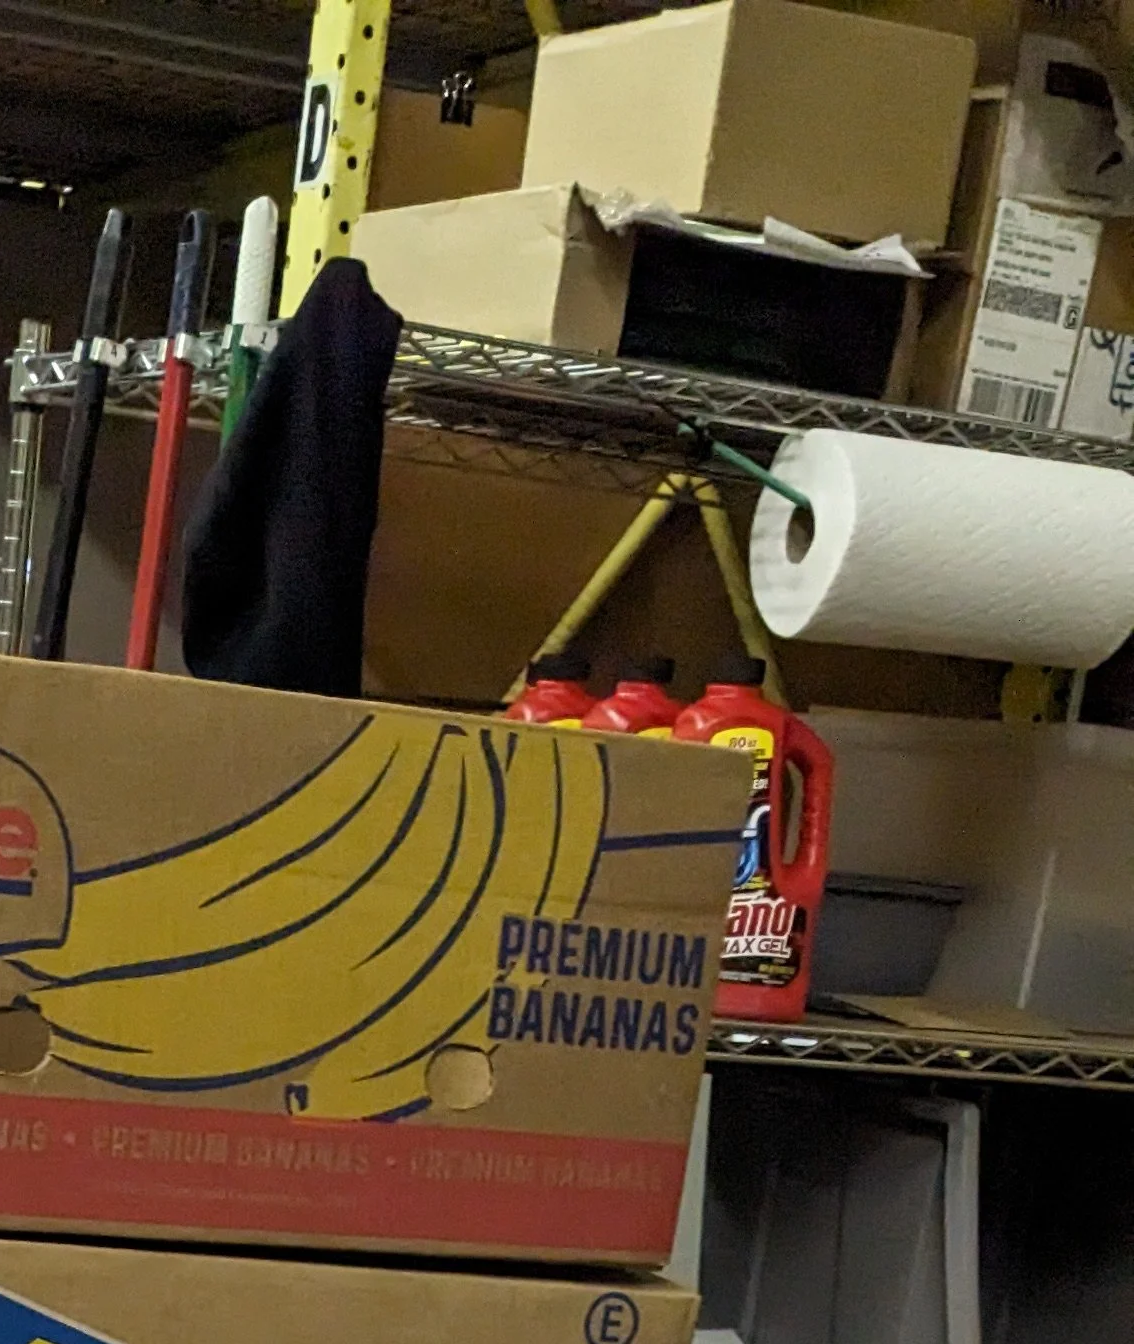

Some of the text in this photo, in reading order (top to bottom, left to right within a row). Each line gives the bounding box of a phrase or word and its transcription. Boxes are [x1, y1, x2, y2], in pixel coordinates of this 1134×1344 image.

[300, 84, 331, 183] D
[726, 903, 793, 937] ano
[497, 914, 706, 988] PREMIUM
[758, 938, 791, 956] GEL
[486, 984, 698, 1055] BANANAS
[91, 1123, 228, 1164] PREMIUM
[237, 1135, 370, 1176] BANANAS
[600, 1303, 624, 1343] E
